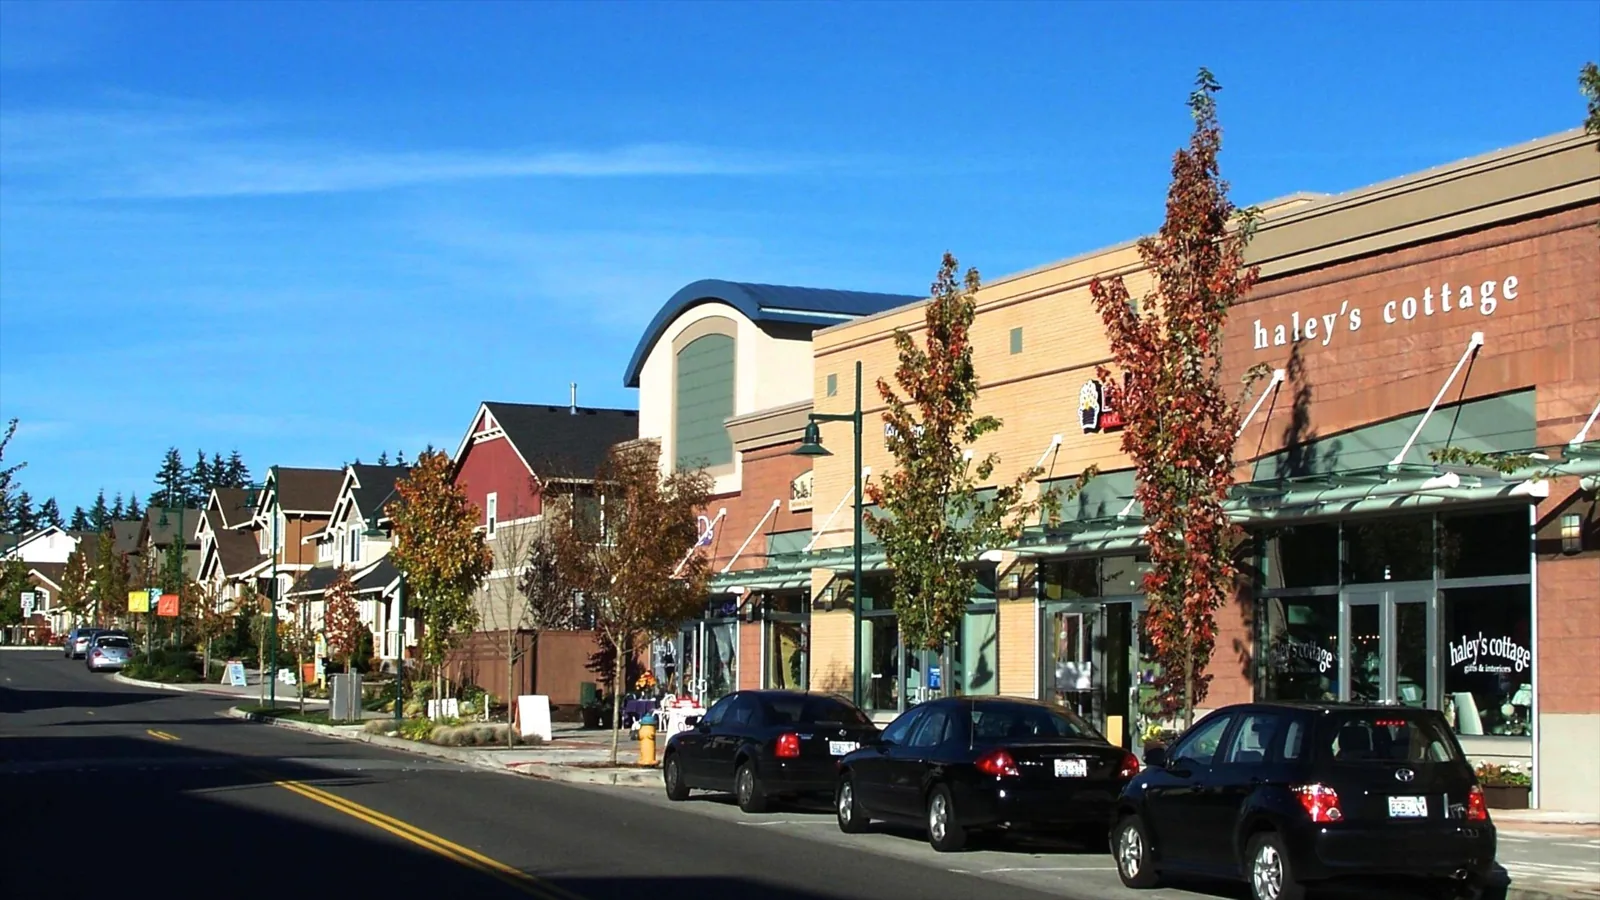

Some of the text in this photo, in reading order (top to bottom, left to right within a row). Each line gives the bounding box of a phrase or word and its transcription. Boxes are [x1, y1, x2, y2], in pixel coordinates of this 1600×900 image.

[1253, 275, 1519, 350] haley's cottage
[1449, 631, 1531, 673] haley's cottage
[1478, 663, 1484, 672] &
